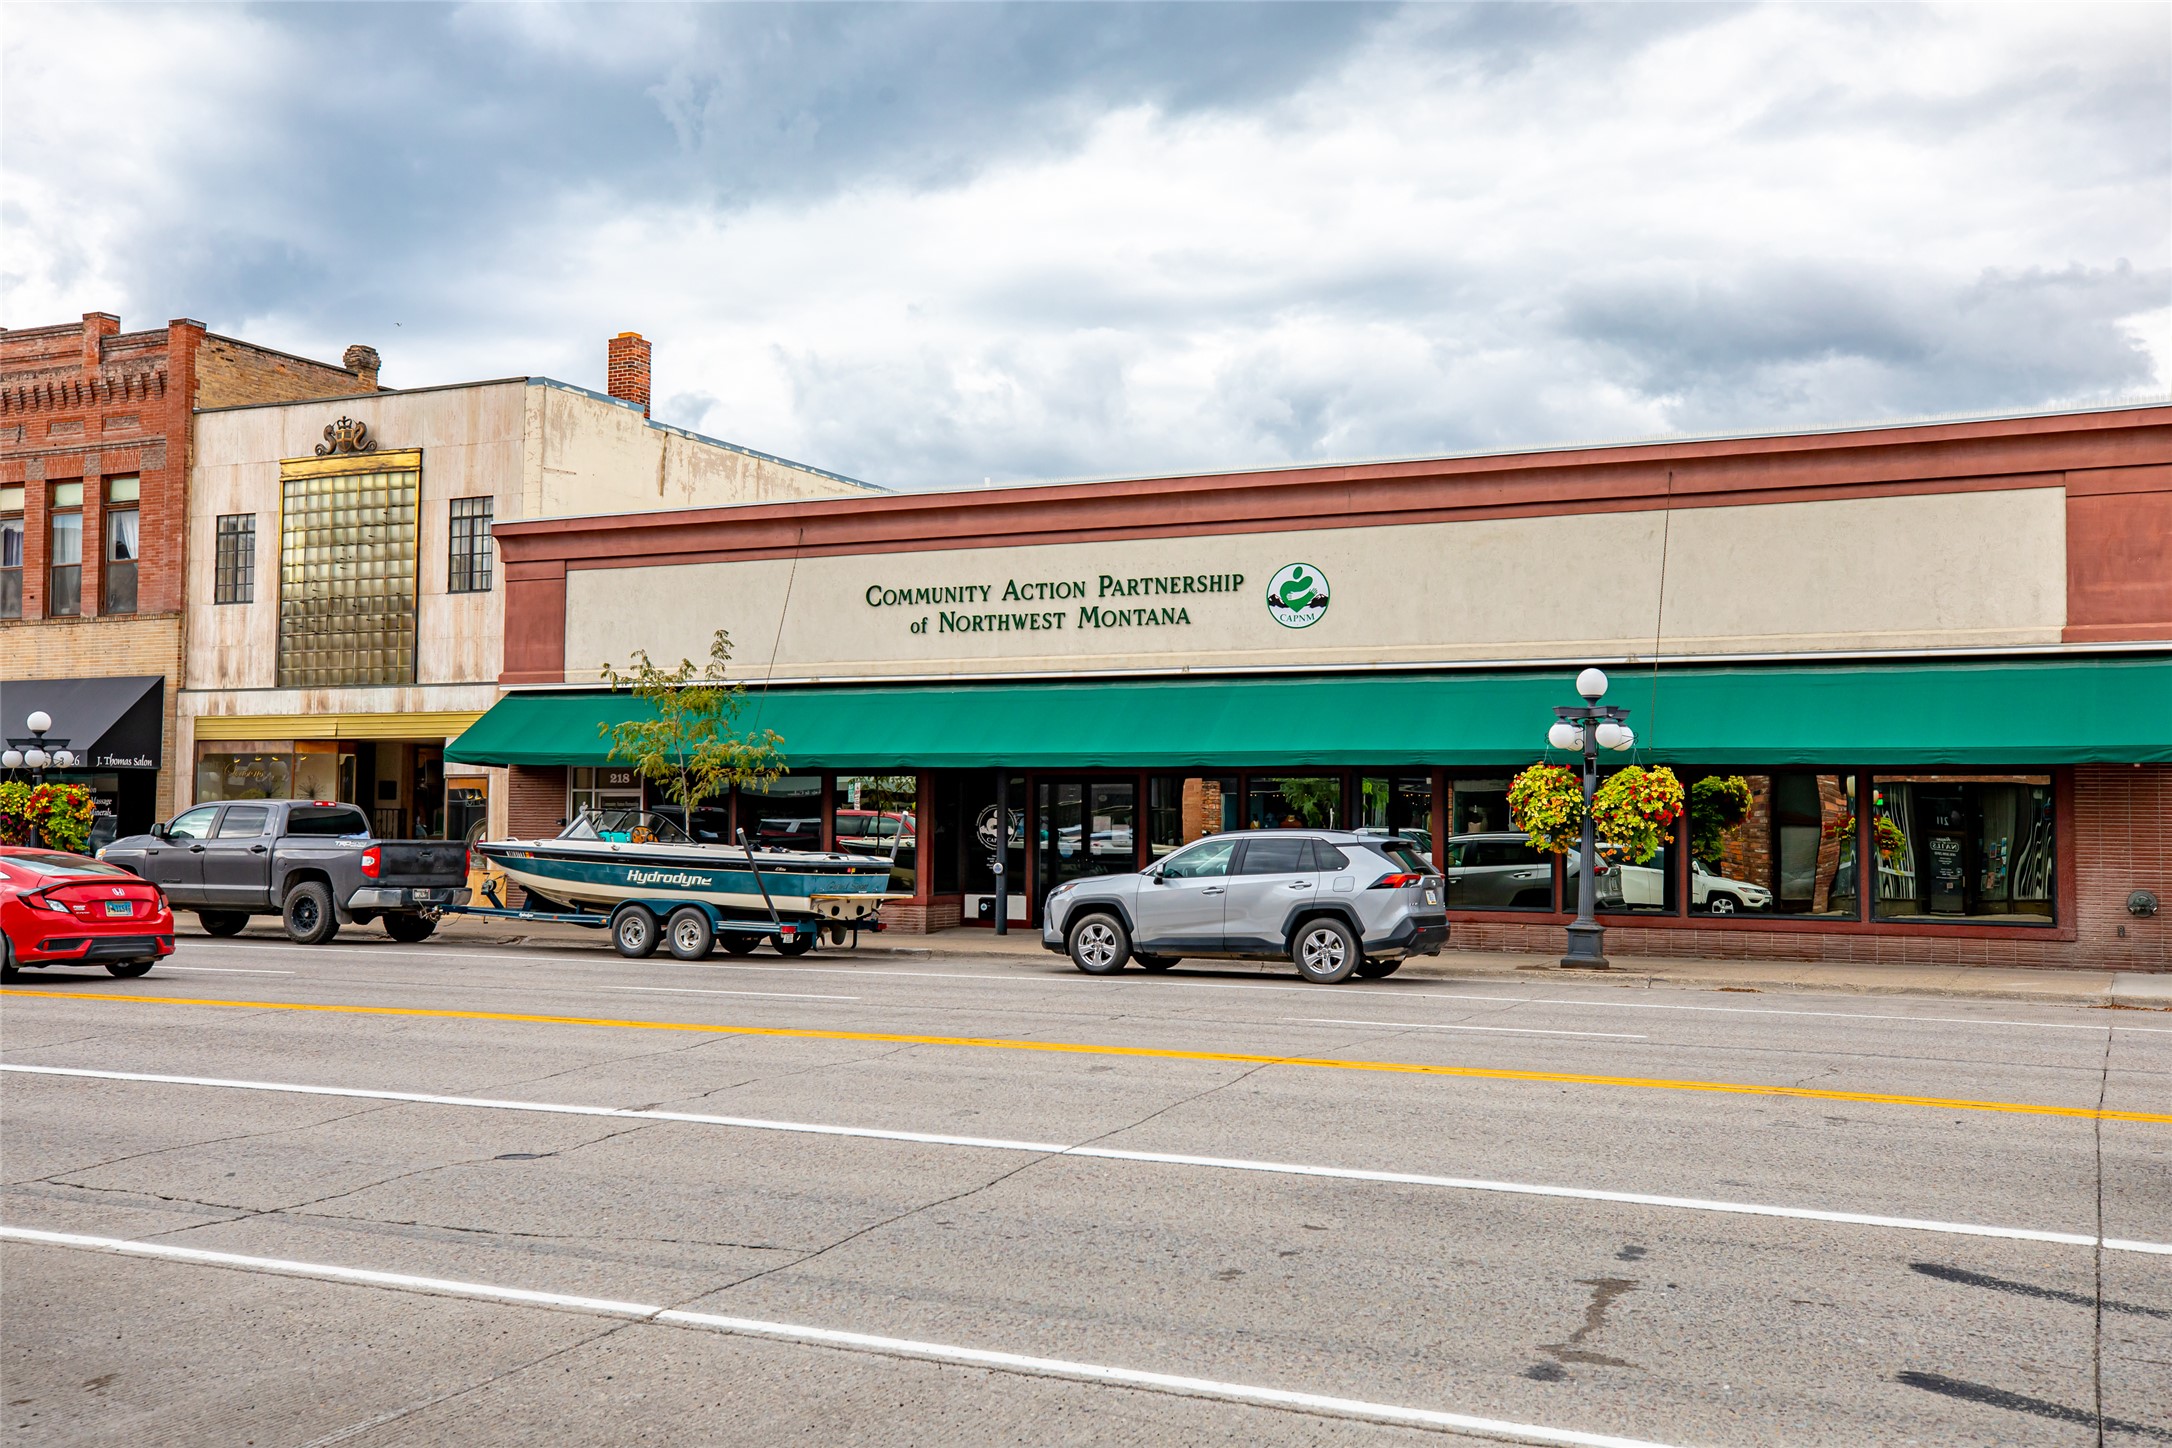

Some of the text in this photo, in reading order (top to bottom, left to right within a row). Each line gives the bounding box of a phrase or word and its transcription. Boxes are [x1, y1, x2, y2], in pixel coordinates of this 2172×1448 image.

[866, 573, 1245, 607] COMMUNITY ACTION PARTNERSHIP
[910, 606, 1191, 633] of NORTHWEST MONTANA
[1280, 613, 1315, 622] CAPNM
[96, 753, 153, 767] J. Thomas Salon
[610, 773, 630, 784] 218
[626, 869, 713, 887] Hydrodyne
